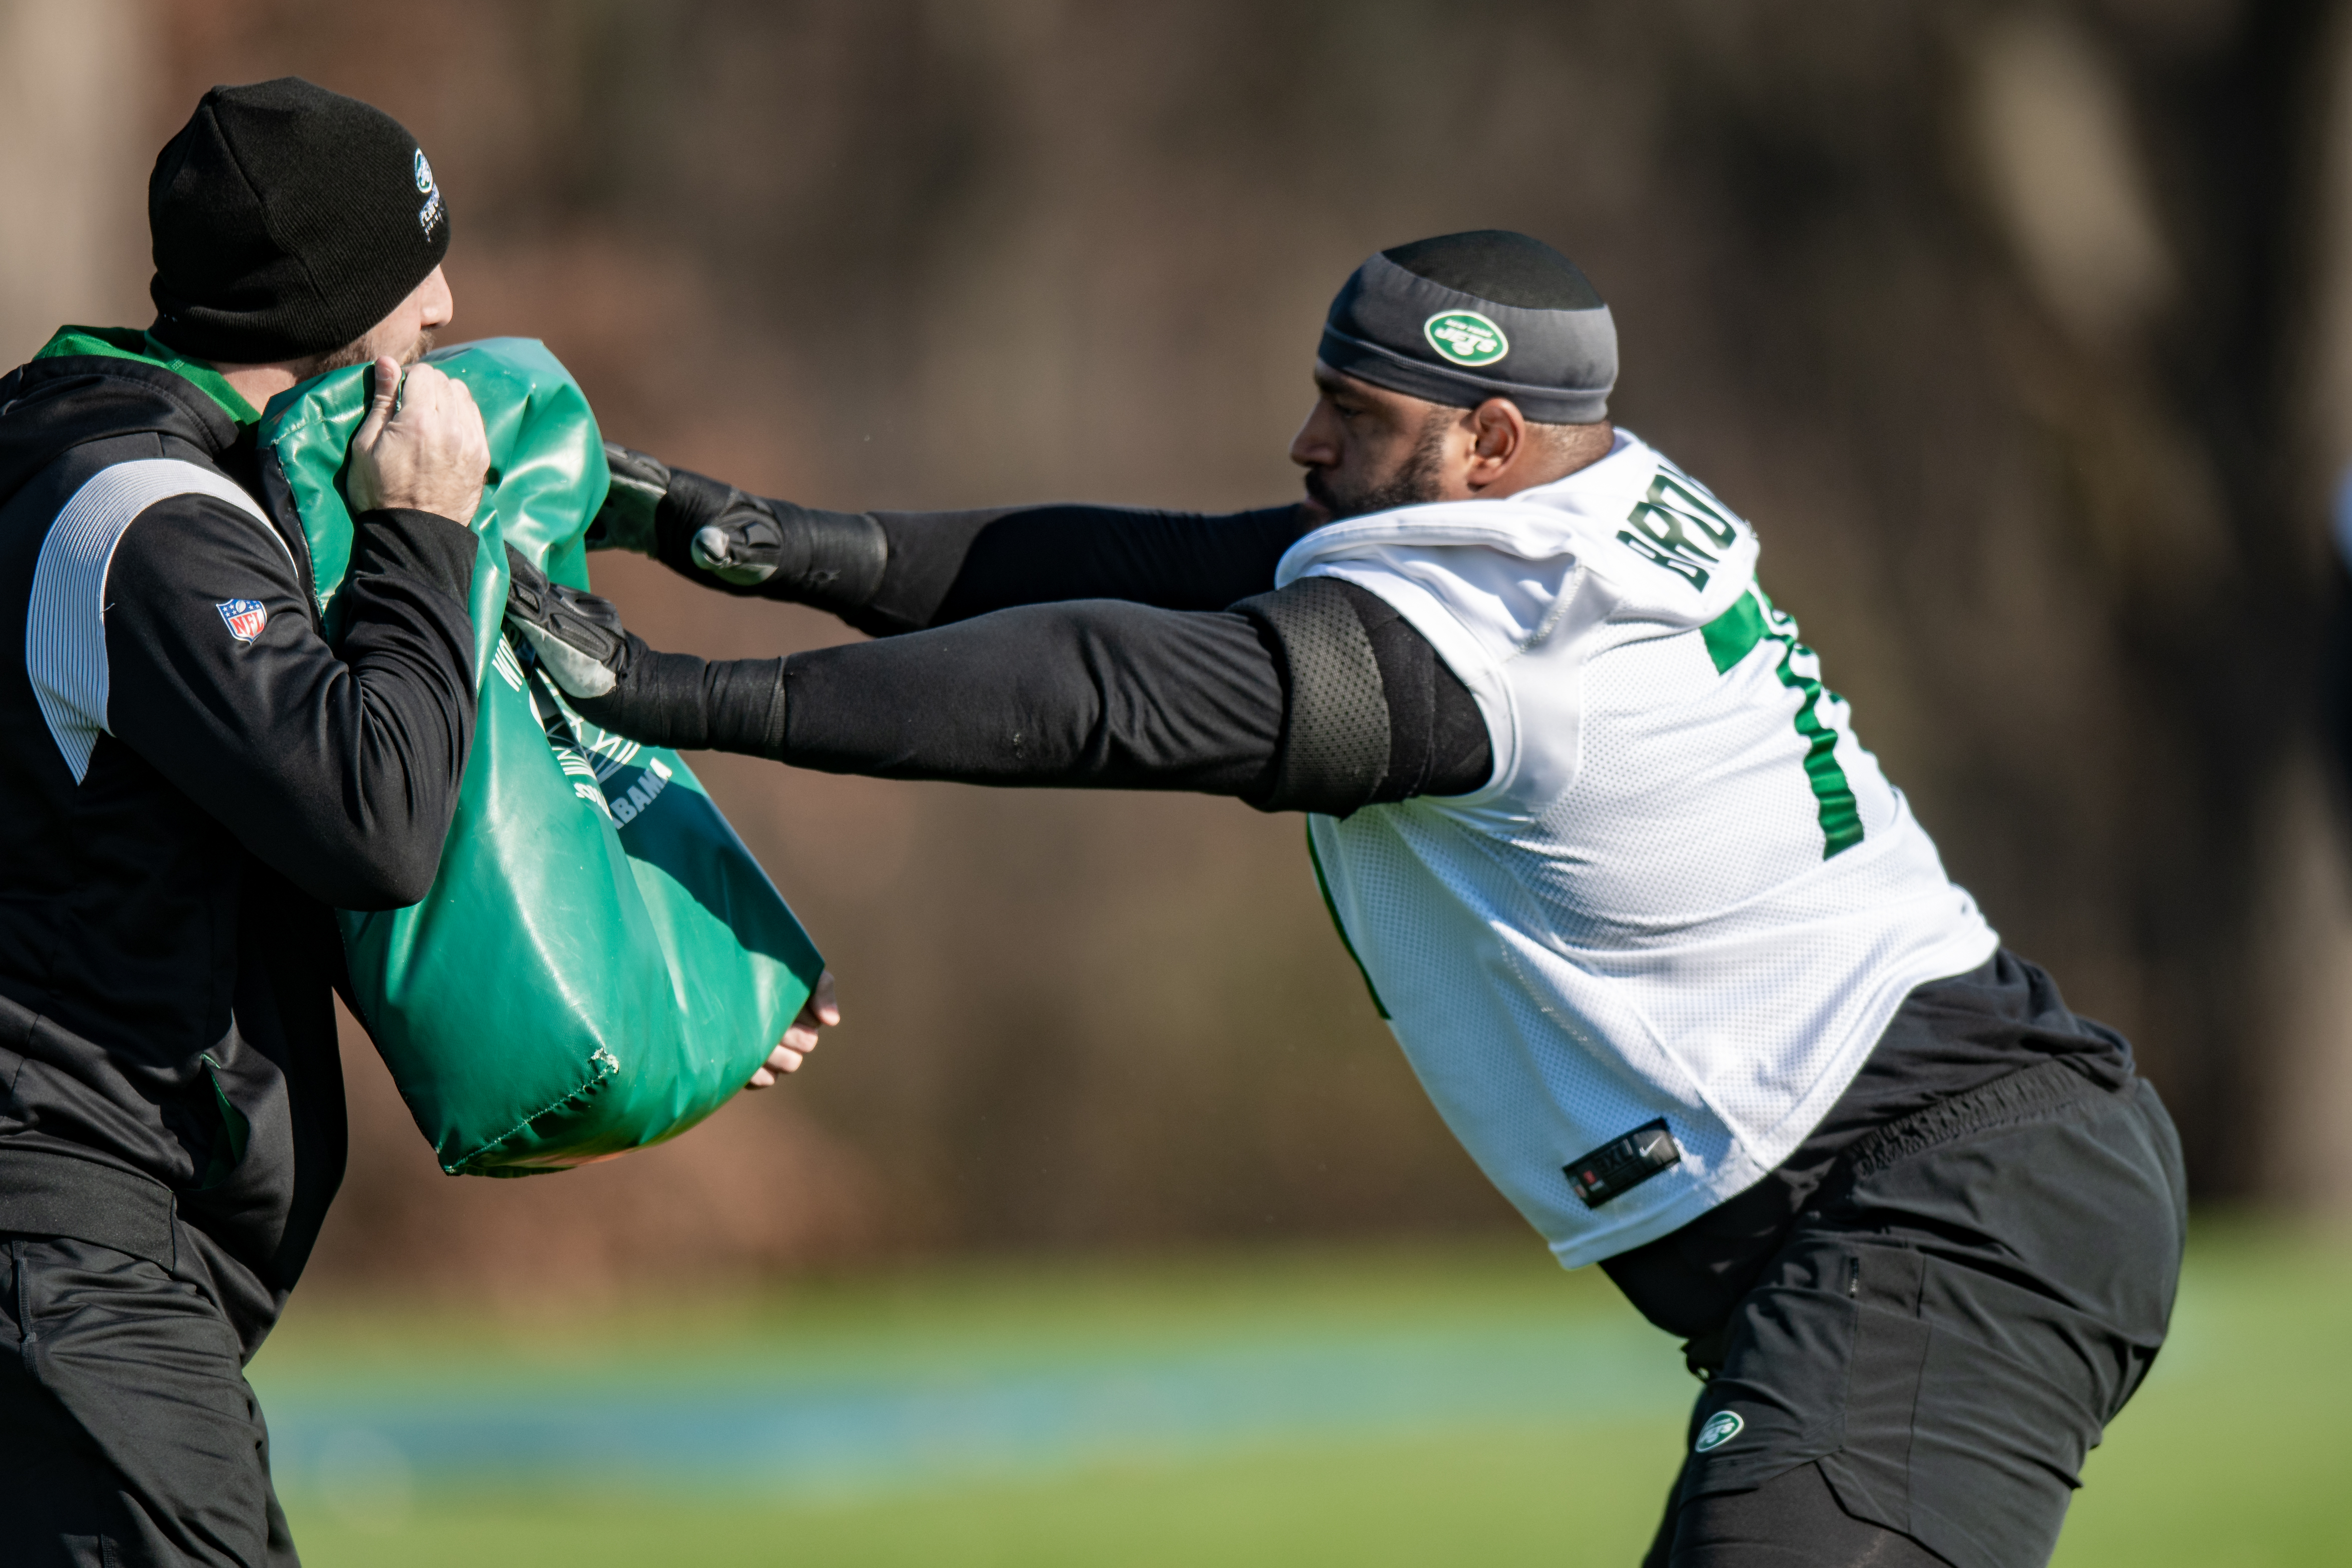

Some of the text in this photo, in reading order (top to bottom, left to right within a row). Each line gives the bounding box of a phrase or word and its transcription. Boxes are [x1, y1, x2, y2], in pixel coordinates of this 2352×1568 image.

[1434, 327, 1497, 353] JETS
[230, 612, 264, 636] NFL
[1699, 570, 1865, 862] 7
[609, 757, 672, 830] BAMA
